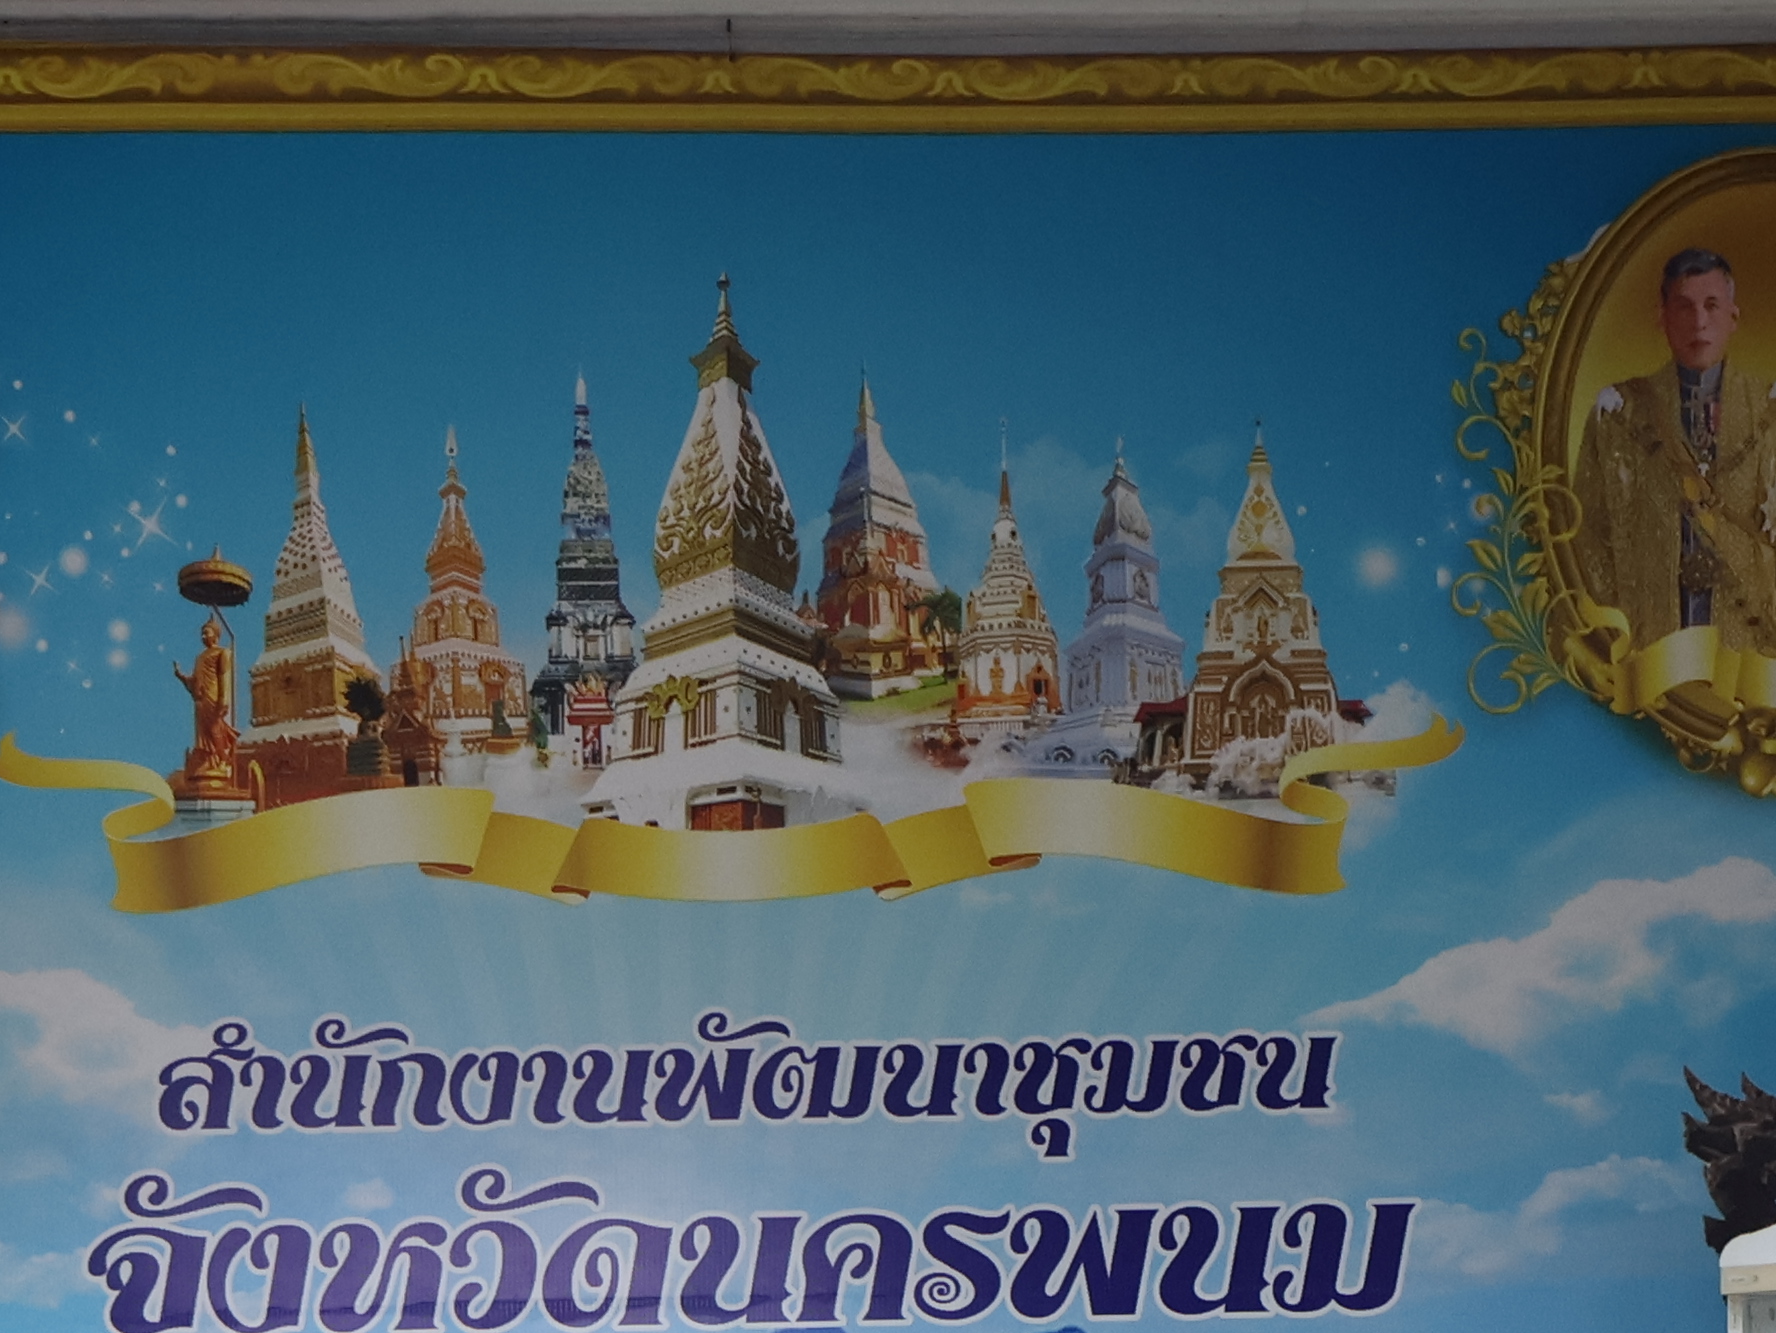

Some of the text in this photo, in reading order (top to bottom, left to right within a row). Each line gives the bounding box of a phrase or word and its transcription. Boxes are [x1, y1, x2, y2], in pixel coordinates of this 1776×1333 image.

[158, 1011, 1338, 1162] สำนักงานพัฒนาชุมชน
